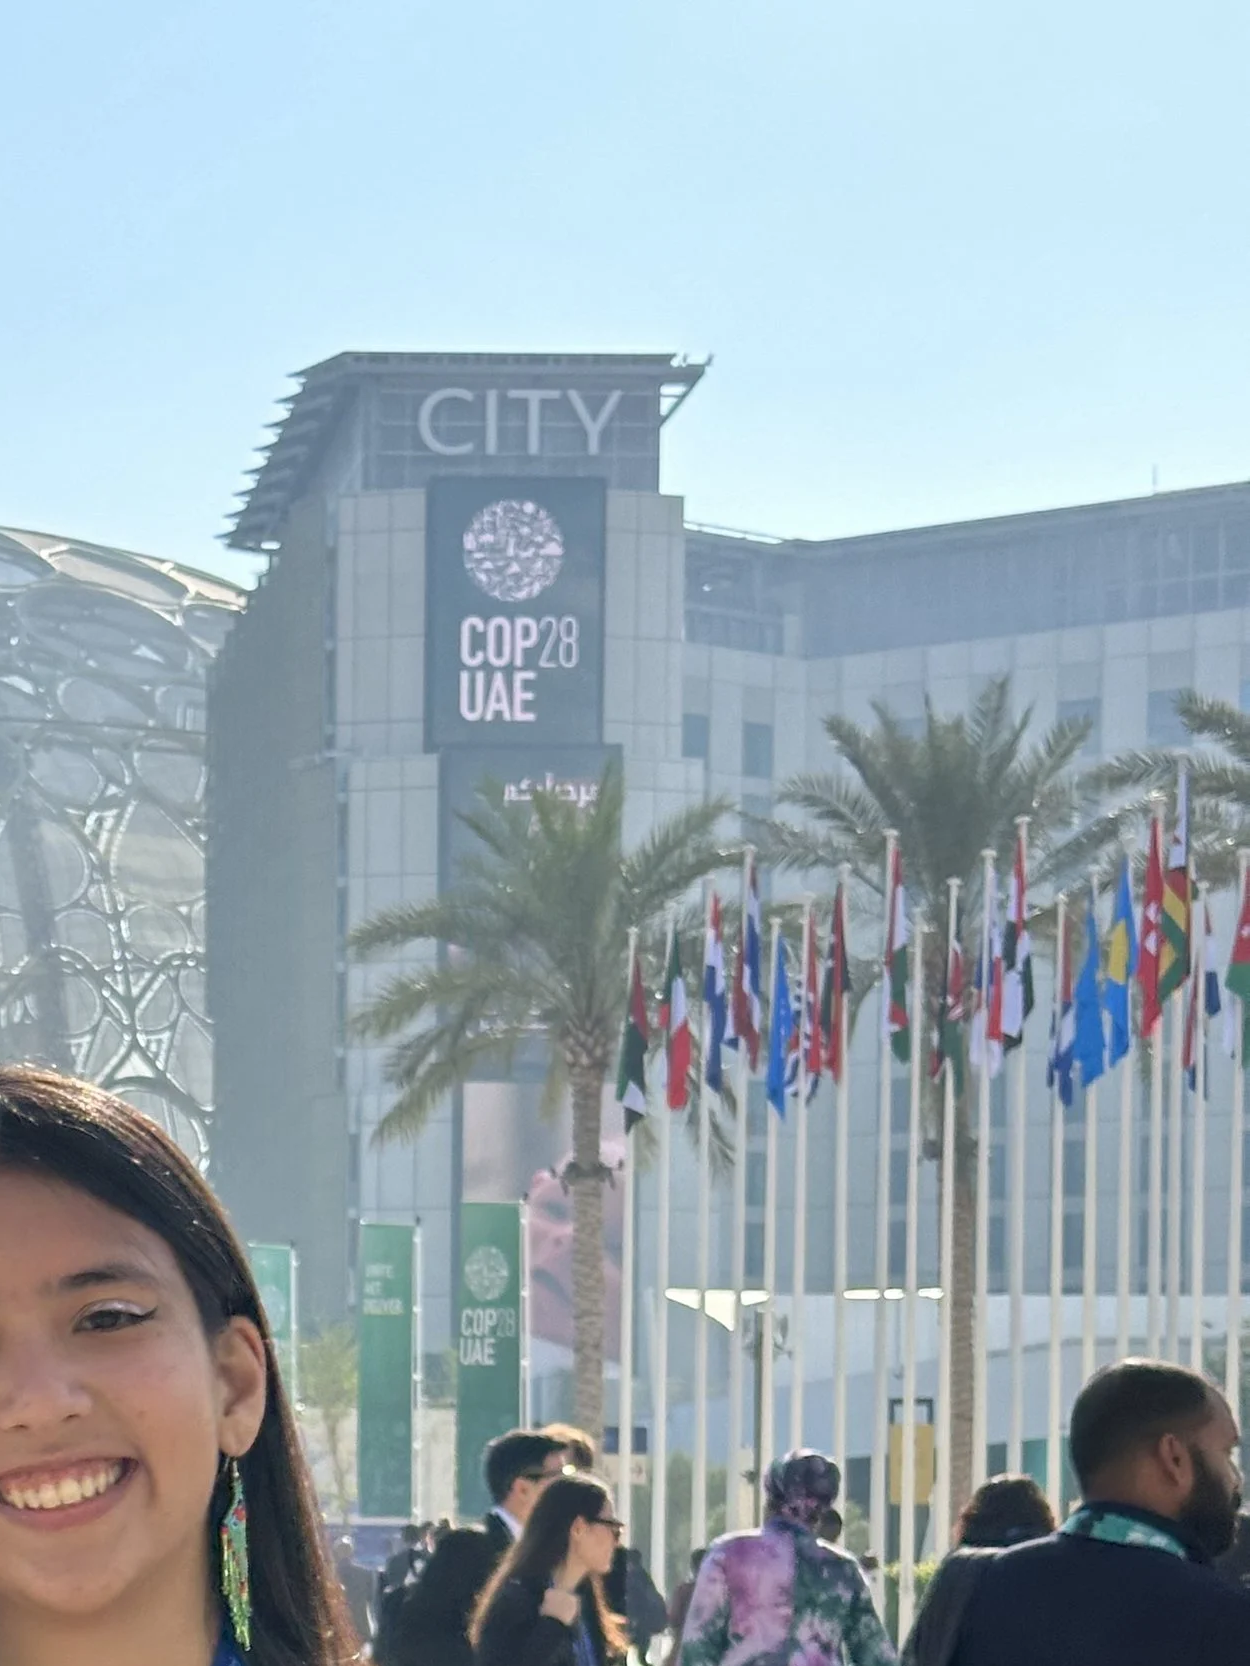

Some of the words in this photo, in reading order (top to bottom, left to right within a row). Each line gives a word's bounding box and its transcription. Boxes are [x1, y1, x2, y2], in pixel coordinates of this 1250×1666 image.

[417, 388, 623, 457] CITY
[459, 615, 580, 668] COP28
[458, 669, 538, 722] UAE
[461, 1307, 516, 1337] COP28
[458, 1337, 496, 1366] UAE
